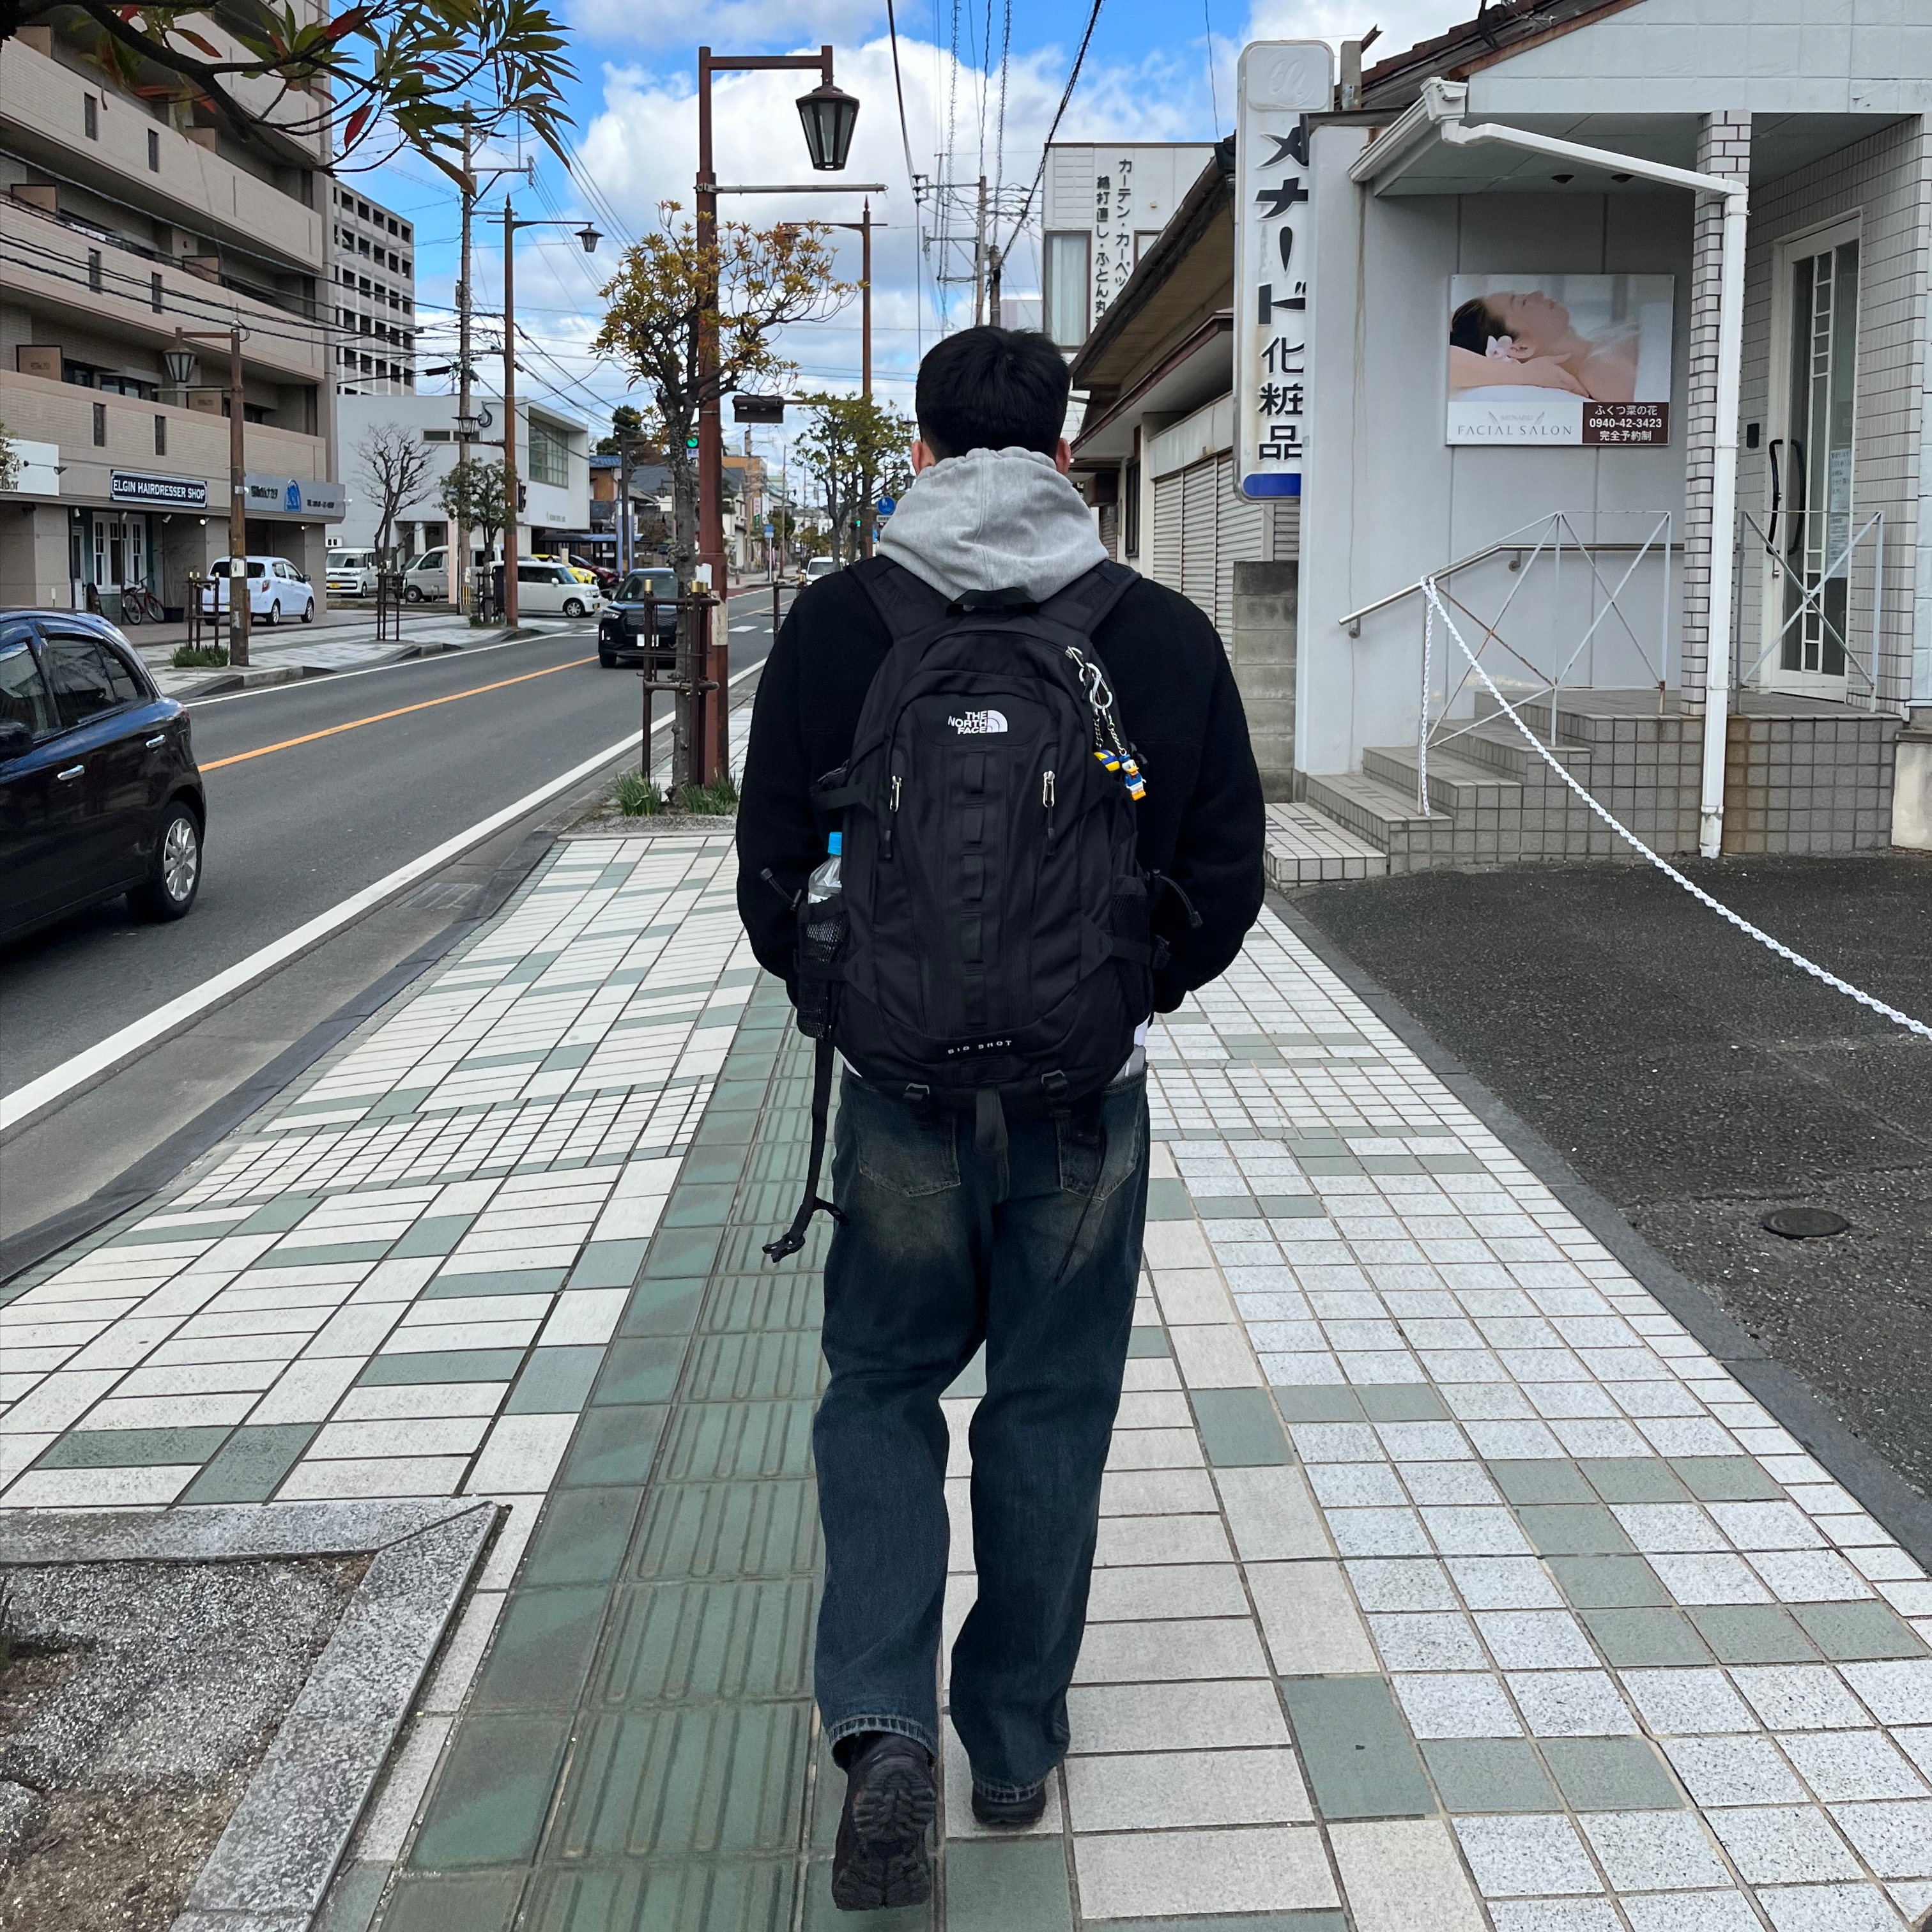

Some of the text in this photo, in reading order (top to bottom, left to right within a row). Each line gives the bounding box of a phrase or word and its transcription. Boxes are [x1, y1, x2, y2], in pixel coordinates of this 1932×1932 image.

[1115, 158, 1132, 287] カーテン・カーペッ
[1255, 126, 1308, 461] メナード化粧品
[1595, 404, 1658, 416] ふくつ菜の花
[1589, 418, 1662, 428] 0940-42-3423
[1458, 425, 1572, 436] FACIAL SALON
[1599, 430, 1652, 441] 完全予約制
[113, 479, 205, 500] ELGIN HAIRDRESSER SHOP
[965, 710, 987, 721] THE
[947, 716, 987, 728] NORTH
[957, 726, 986, 735] FACE
